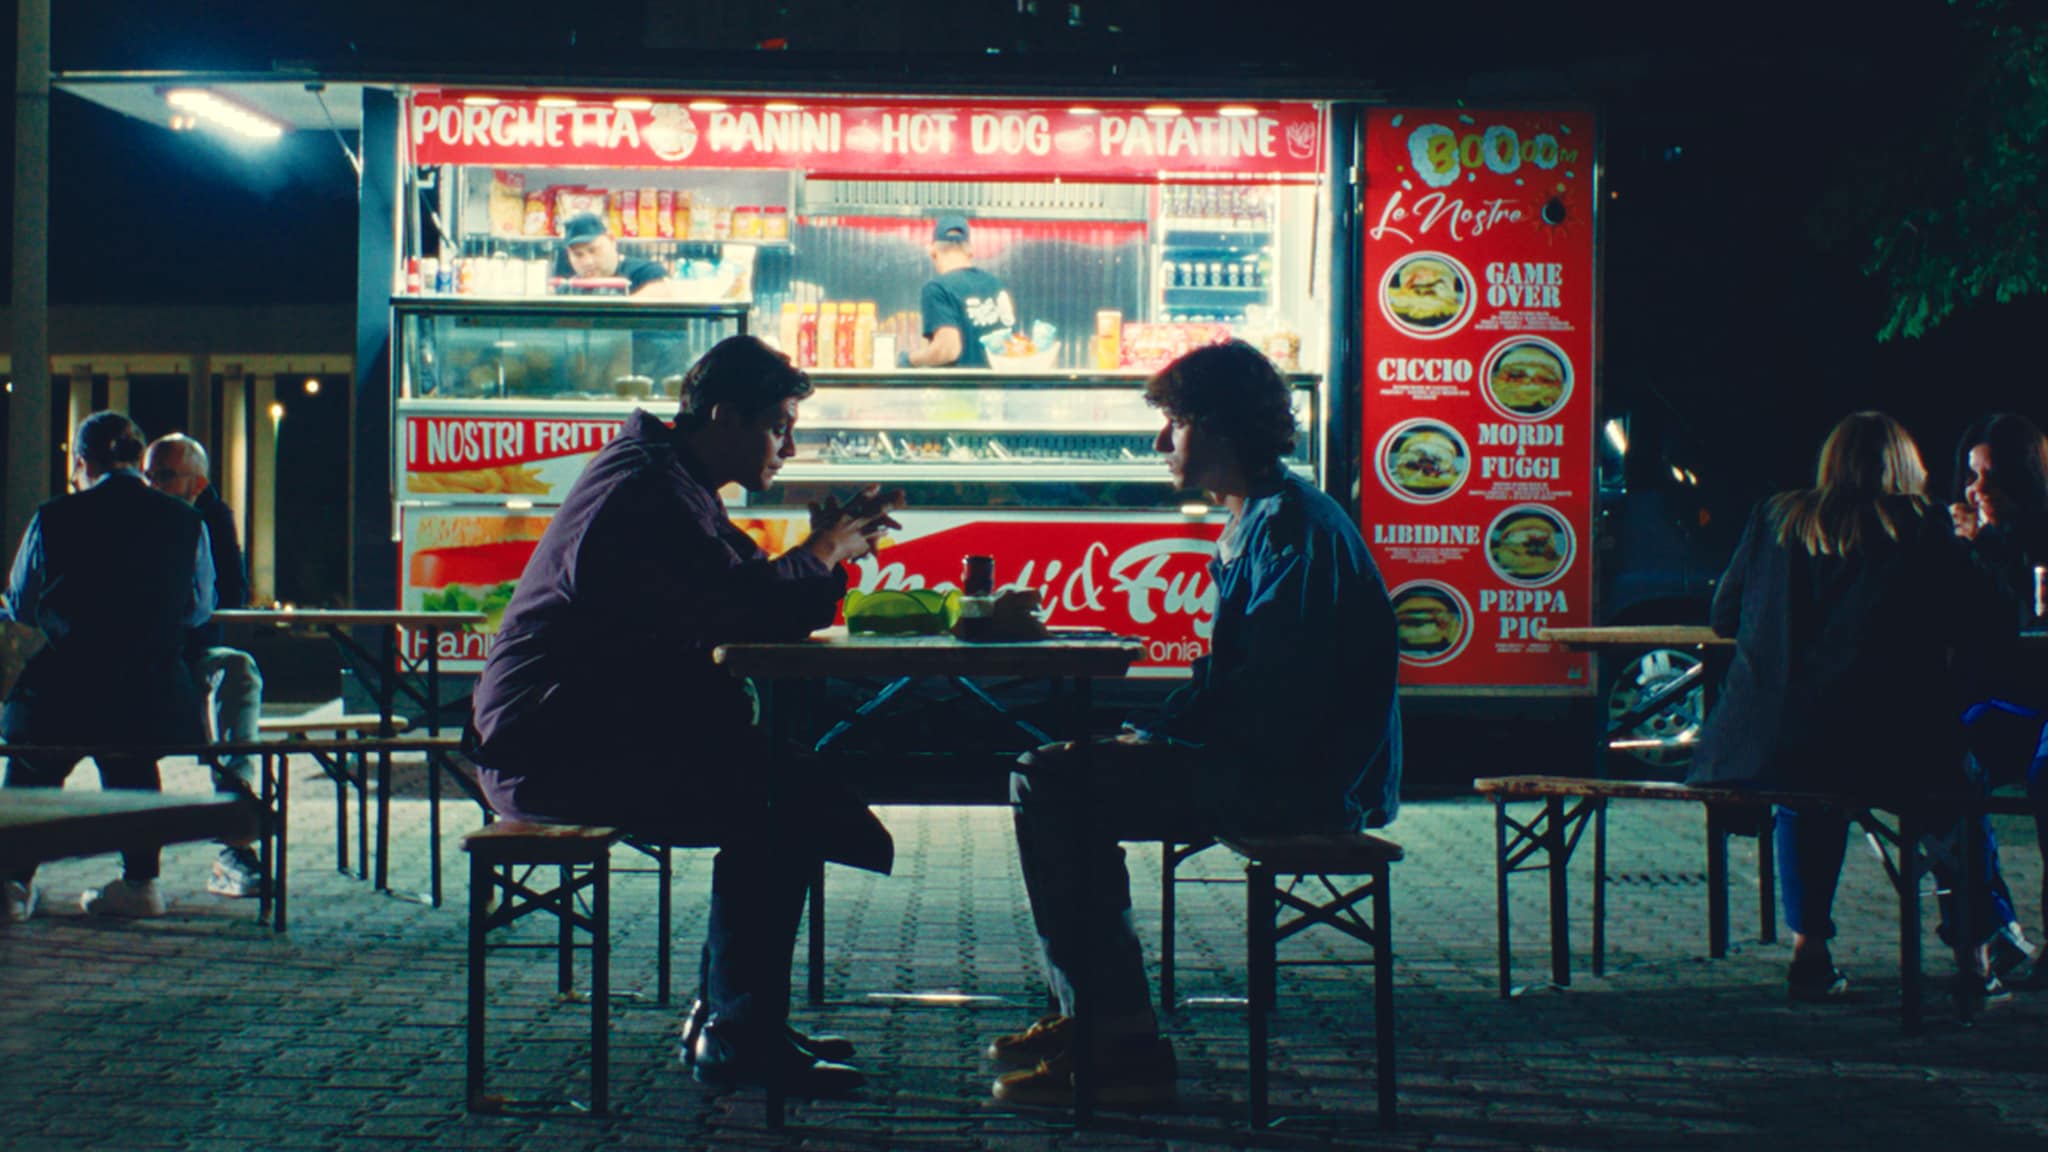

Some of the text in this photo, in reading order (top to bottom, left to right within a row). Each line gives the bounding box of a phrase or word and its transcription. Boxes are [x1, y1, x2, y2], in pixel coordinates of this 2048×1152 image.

[414, 105, 1278, 156] PORCHETTA PANINI HOT DOG PATATINE
[1412, 192, 1523, 241] Nostre
[1485, 262, 1563, 286] GAME
[1487, 285, 1561, 308] OVER
[1377, 357, 1473, 382] CICCIO
[408, 421, 417, 463] I
[427, 420, 524, 465] NOSTRI
[1478, 423, 1565, 446] MORDI
[1481, 456, 1561, 479] FUGGI
[1374, 524, 1480, 545] LIBIDINE
[1479, 589, 1569, 613] PEPPA
